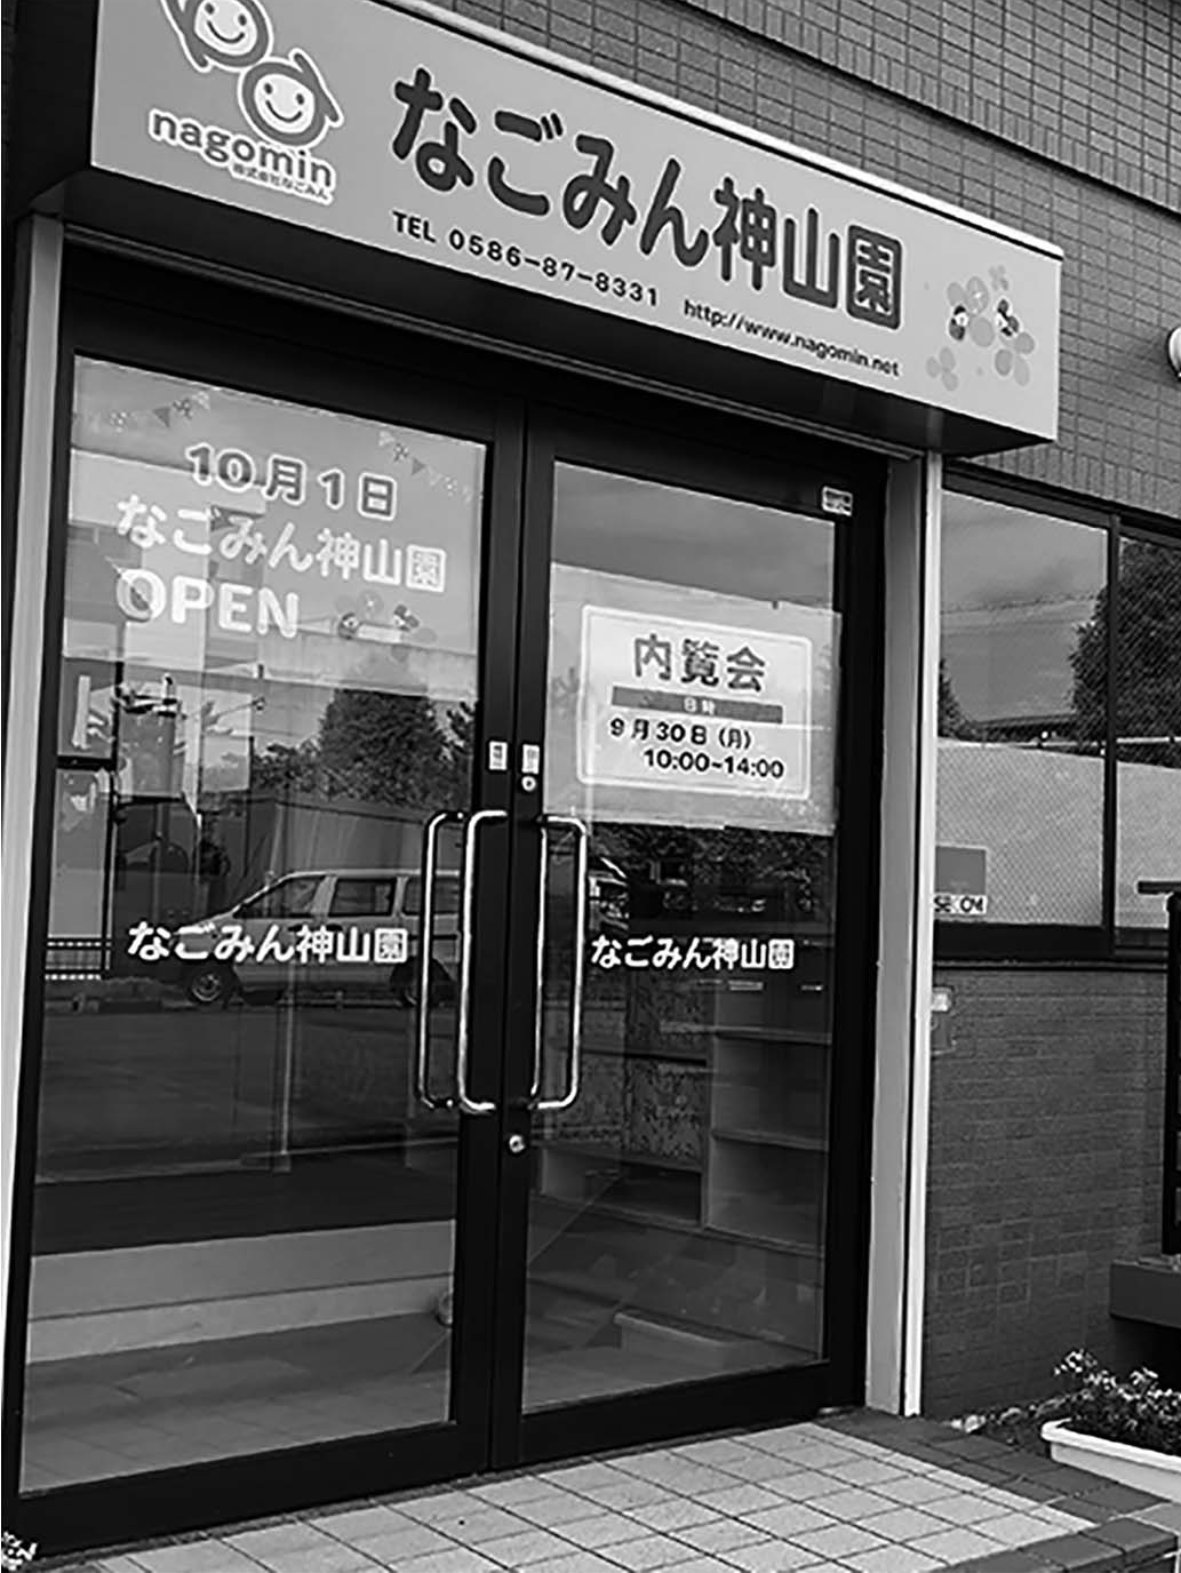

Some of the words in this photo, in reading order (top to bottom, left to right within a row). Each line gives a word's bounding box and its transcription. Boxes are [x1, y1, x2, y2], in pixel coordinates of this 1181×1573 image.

[154, 113, 331, 187] nagomin
[393, 68, 902, 330] なごみん神山園
[392, 210, 436, 243] TEL
[450, 229, 657, 306] 0586-87-8331
[684, 299, 899, 376] http://www.nagomin.net
[117, 495, 446, 592] なごみん神山園
[117, 569, 299, 638] OPEN
[633, 633, 766, 692] 内覧会
[128, 922, 408, 963] なごみん神山園
[590, 935, 794, 970] なごみん神山園
